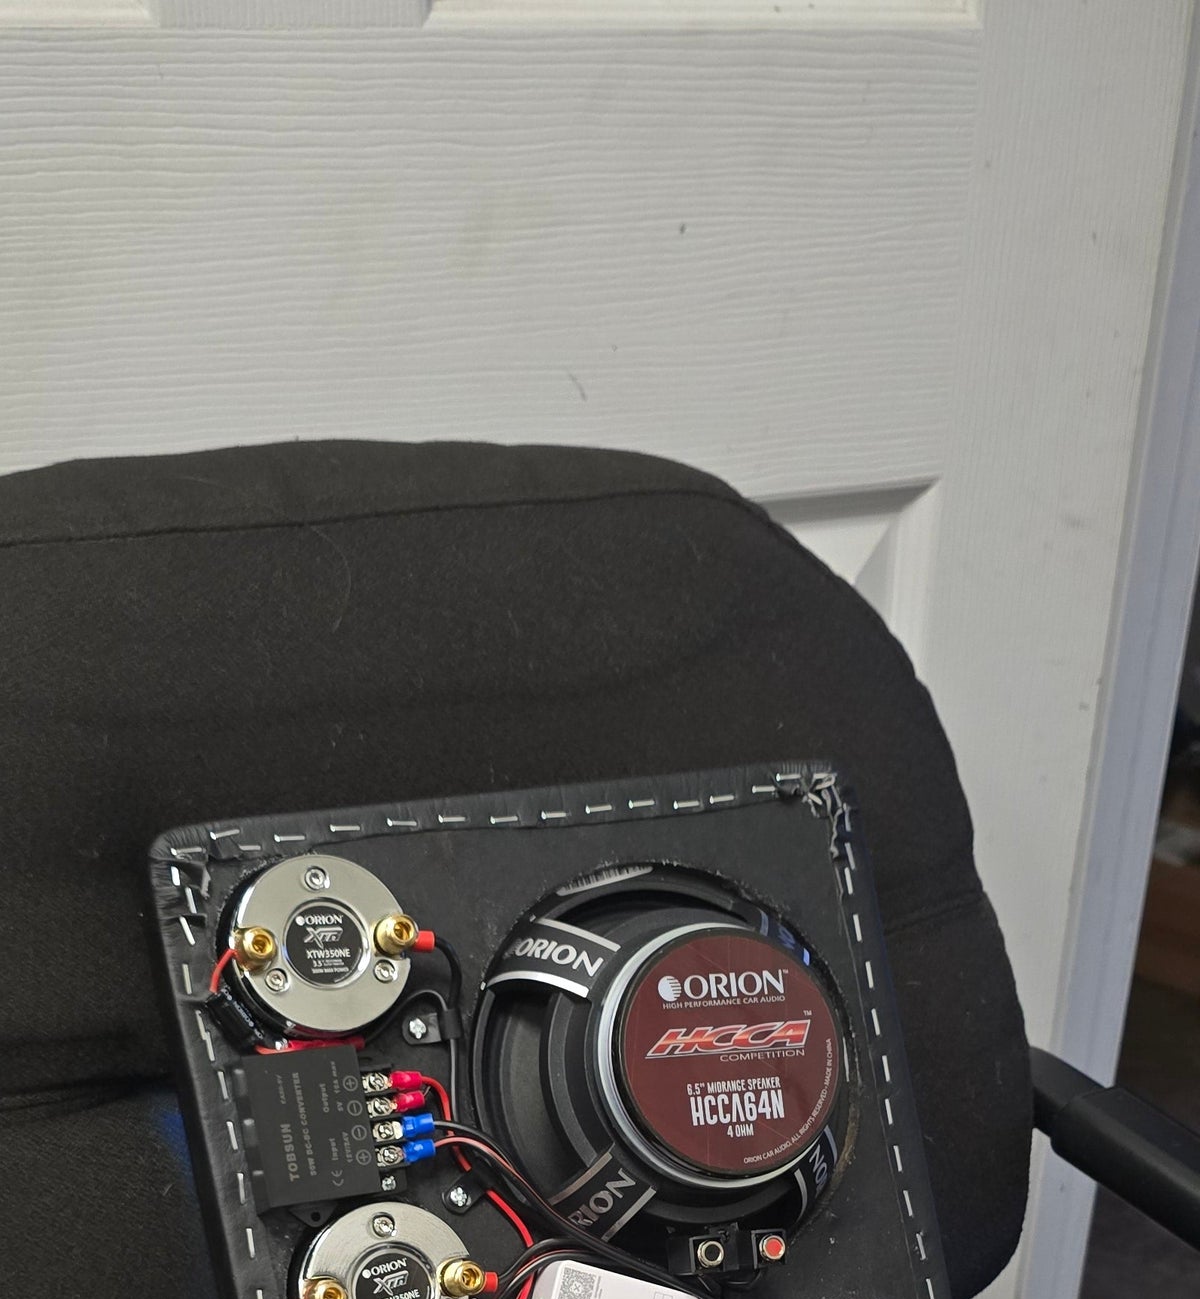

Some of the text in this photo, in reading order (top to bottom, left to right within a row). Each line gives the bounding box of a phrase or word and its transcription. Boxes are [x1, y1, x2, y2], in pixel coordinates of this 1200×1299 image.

[305, 913, 343, 925] ORION
[306, 948, 351, 959] XTW350NE
[515, 938, 604, 977] ORION
[684, 969, 785, 999] ORION
[662, 995, 785, 1010] HIGH PERFORMANCE CAR AUDIO
[646, 1019, 811, 1057] HCCA
[720, 1048, 805, 1062] COMPETITION
[292, 1072, 308, 1126] CONVERTER
[319, 1083, 330, 1113] Output
[687, 1076, 781, 1096] 6.5" MIDRANGE SPEAKER
[690, 1089, 785, 1127] HCCA64N
[743, 1154, 763, 1164] ORION
[763, 1149, 775, 1160] CAR
[791, 1133, 801, 1144] ALL
[798, 1116, 816, 1136] RIGHTS
[813, 1088, 828, 1118] RESERVED
[824, 1067, 832, 1087] MADE
[727, 1123, 754, 1138] 4 OHM
[280, 1123, 300, 1182] TOBSUN
[328, 1138, 339, 1161] Input
[370, 1258, 407, 1276] ORION
